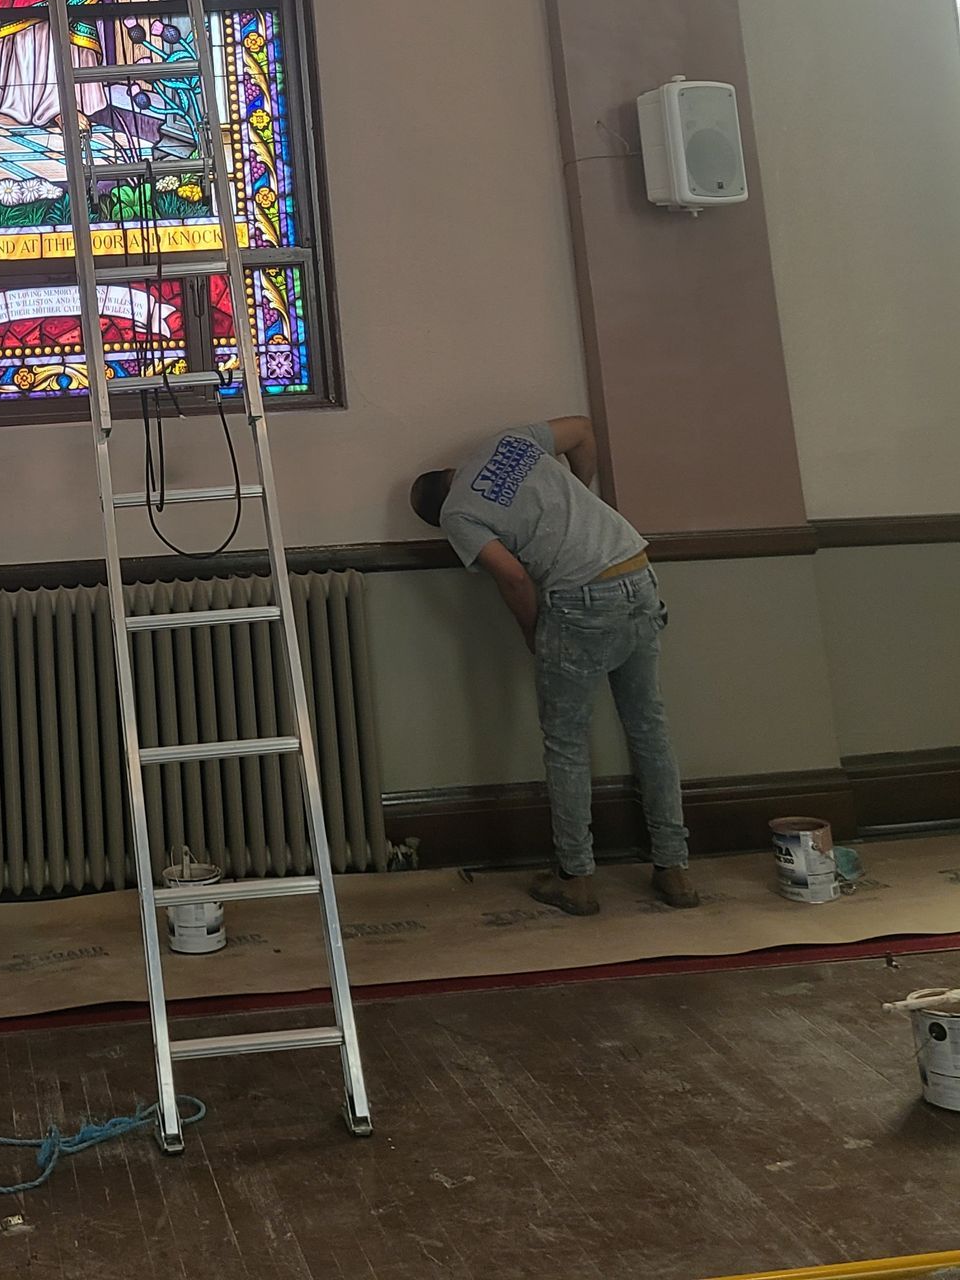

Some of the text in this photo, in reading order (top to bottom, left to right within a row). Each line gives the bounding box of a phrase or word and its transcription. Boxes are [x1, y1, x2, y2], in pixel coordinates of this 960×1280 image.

[21, 238, 39, 254] AT
[44, 236, 76, 252] THE
[93, 233, 124, 250] OOR
[167, 229, 224, 246] KNOCK
[19, 291, 41, 299] LOVING
[44, 288, 73, 297] MEMORY
[16, 299, 53, 307] WILLISTON
[107, 297, 143, 310] WILLISON
[10, 308, 30, 317] THEIR
[32, 306, 61, 314] MOTHER
[105, 305, 143, 319] WILLISON
